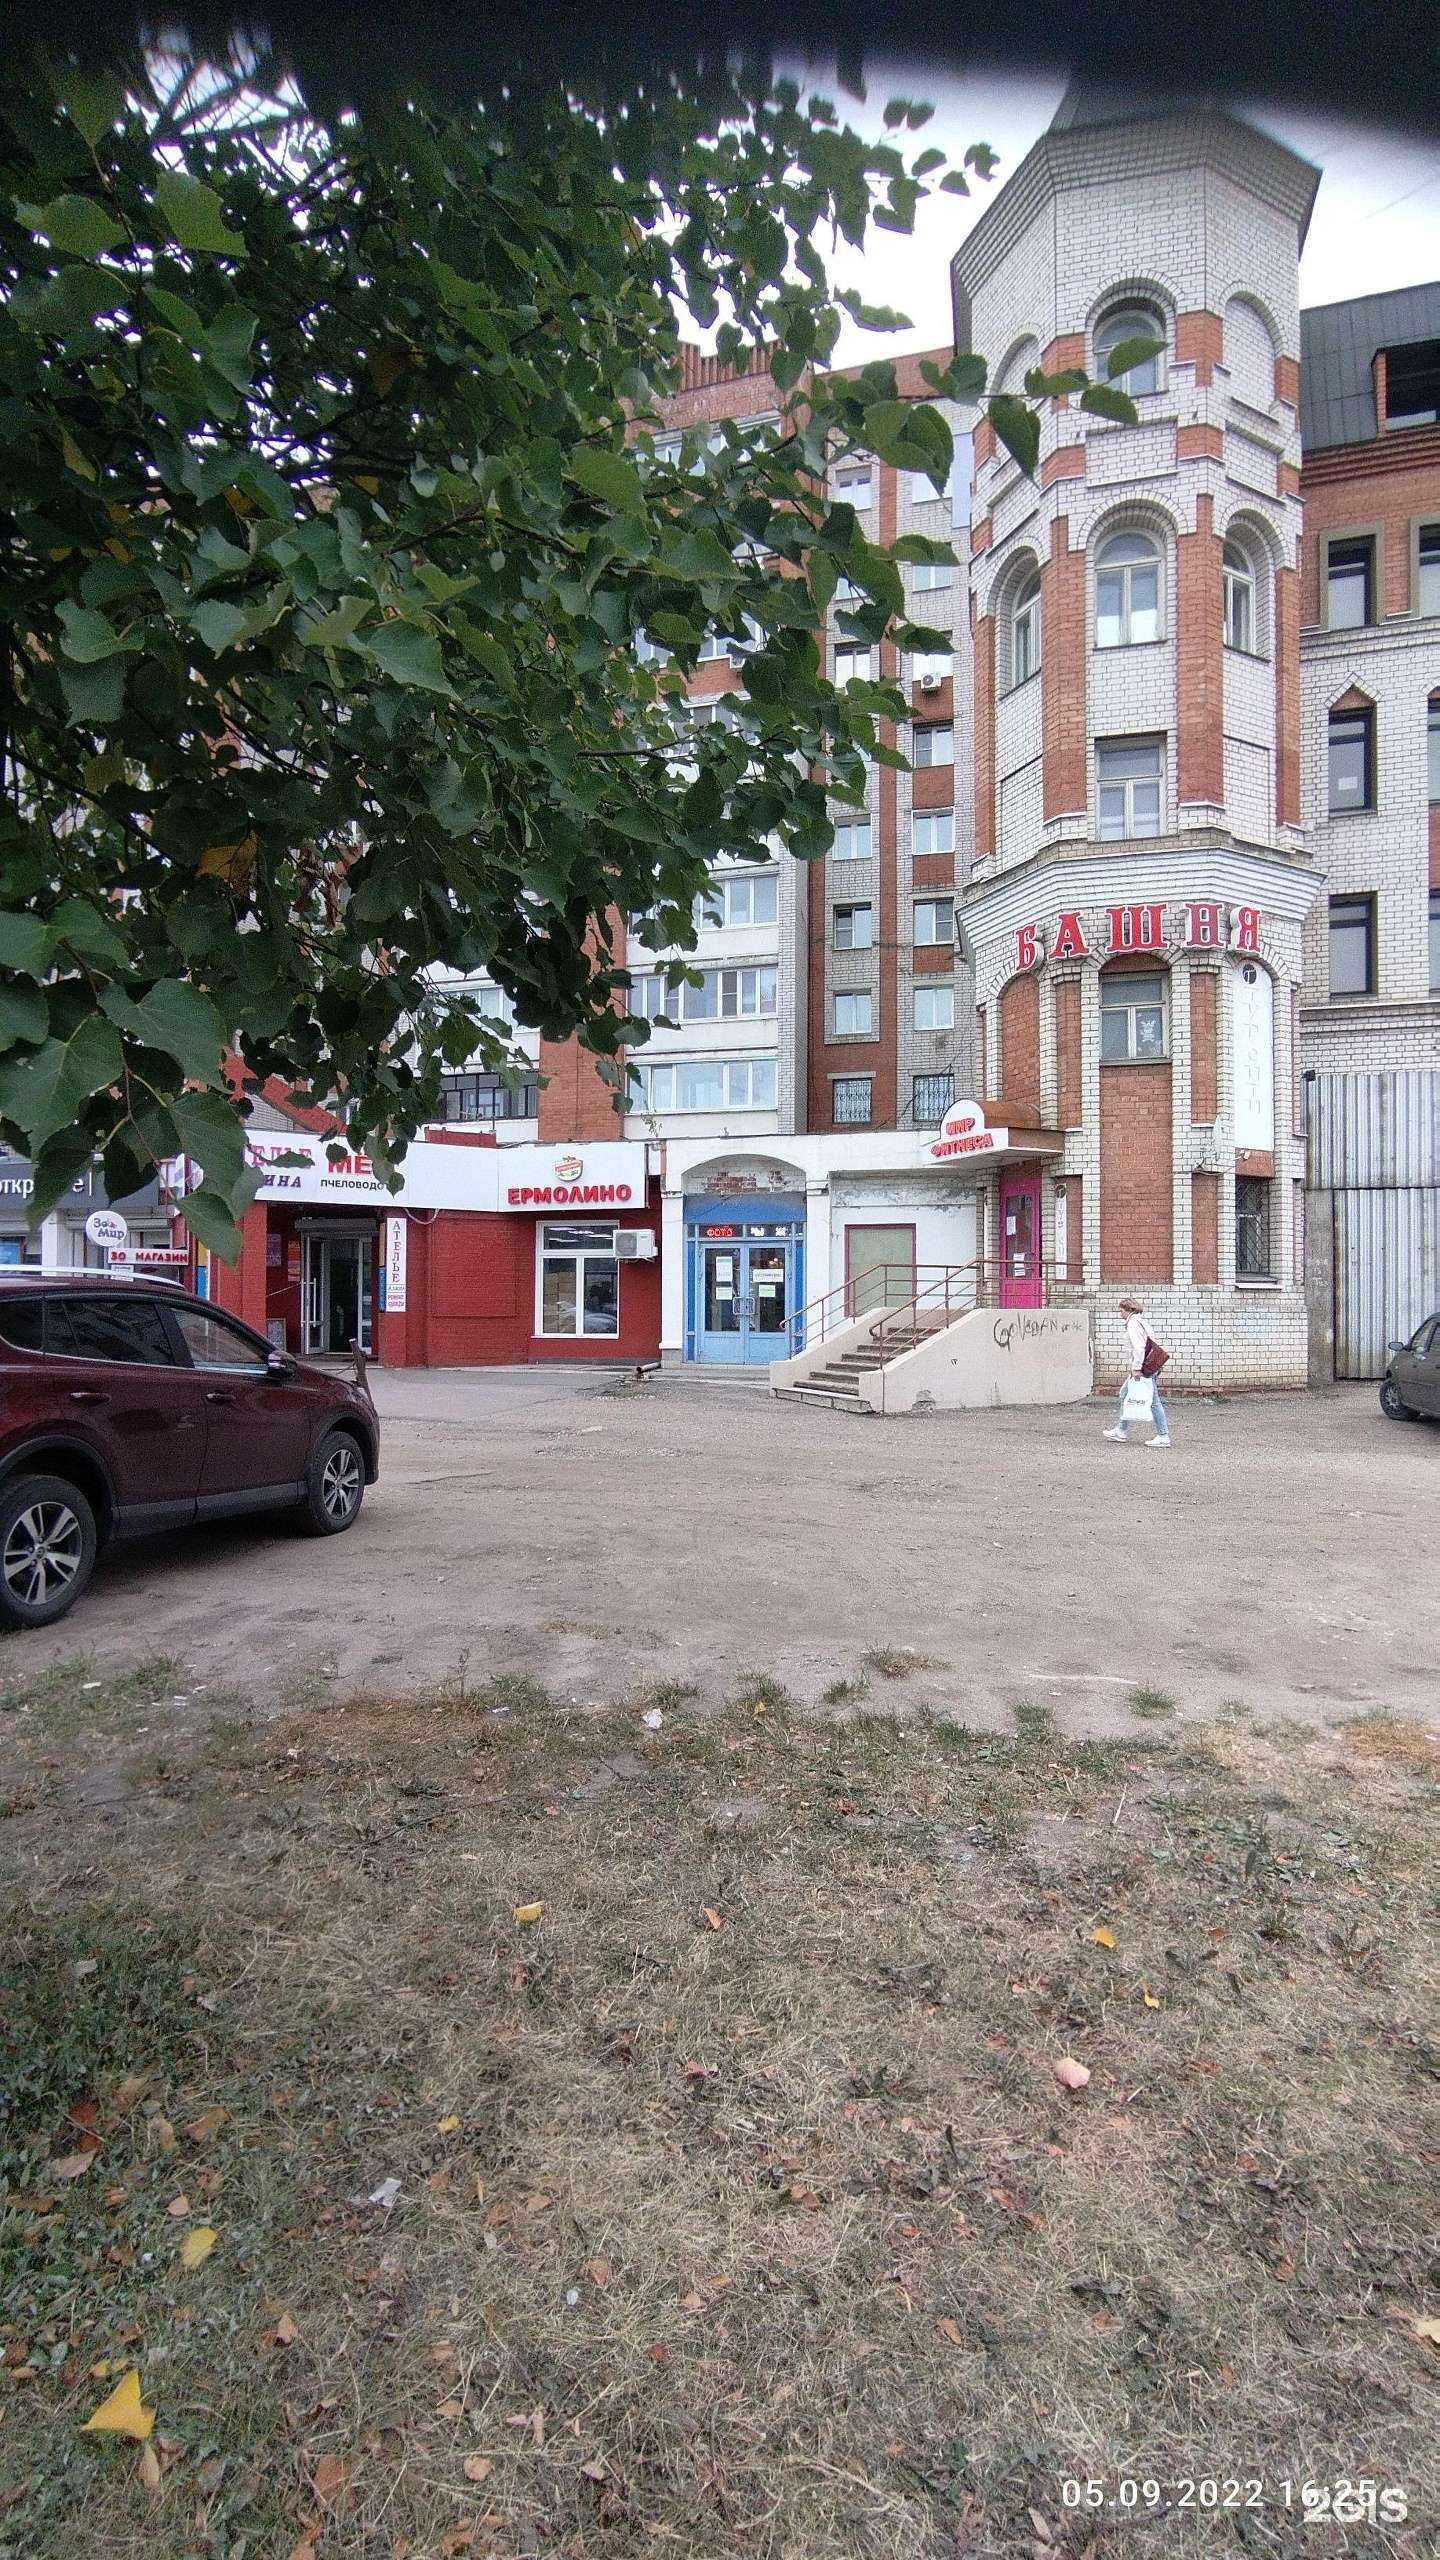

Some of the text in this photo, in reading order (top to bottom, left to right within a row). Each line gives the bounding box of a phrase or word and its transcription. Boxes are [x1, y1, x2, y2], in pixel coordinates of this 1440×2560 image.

[1014, 903, 1261, 972] БАШНЯ
[946, 1118, 976, 1136] МИР
[931, 1133, 994, 1157] ФИТНЕСА
[328, 1154, 372, 1175] МЁ
[264, 1175, 302, 1188] ИНА
[320, 1179, 385, 1191] ПЧЕЛОВОДС
[507, 1184, 632, 1205] ЕРМОЛИНО
[391, 1220, 402, 1283] АТЕЛЬЕ
